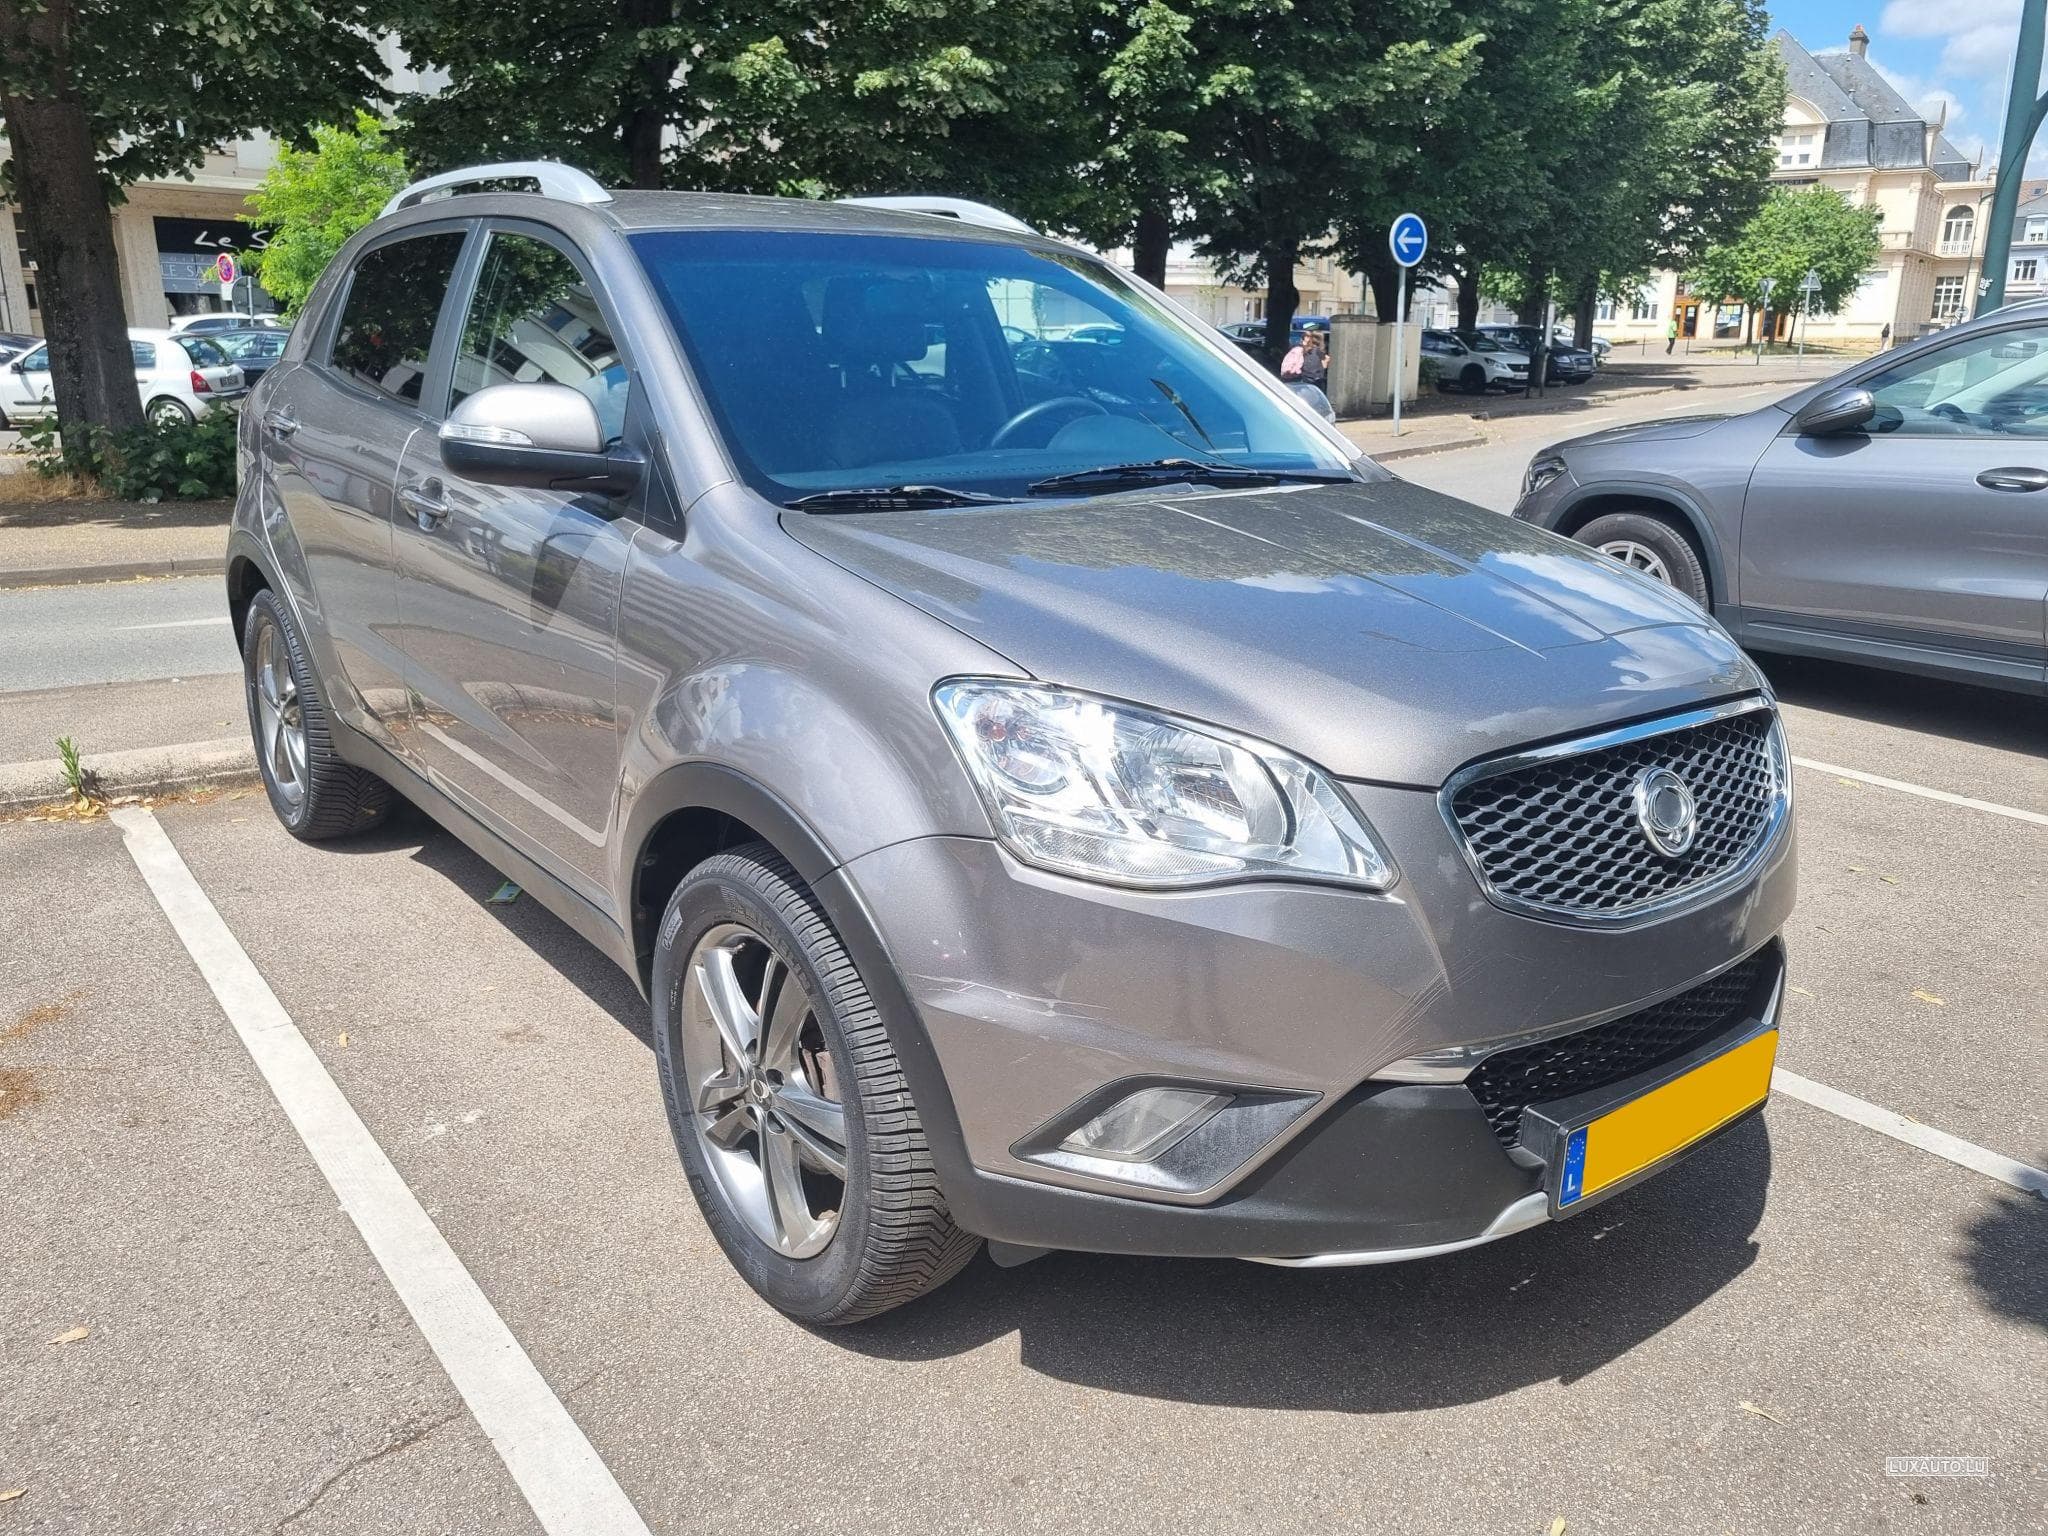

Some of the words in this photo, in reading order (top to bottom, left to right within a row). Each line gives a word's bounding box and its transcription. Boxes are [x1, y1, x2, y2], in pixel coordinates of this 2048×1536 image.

[194, 230, 240, 251] Le
[160, 263, 177, 277] LE
[1567, 1173, 1576, 1192] L
